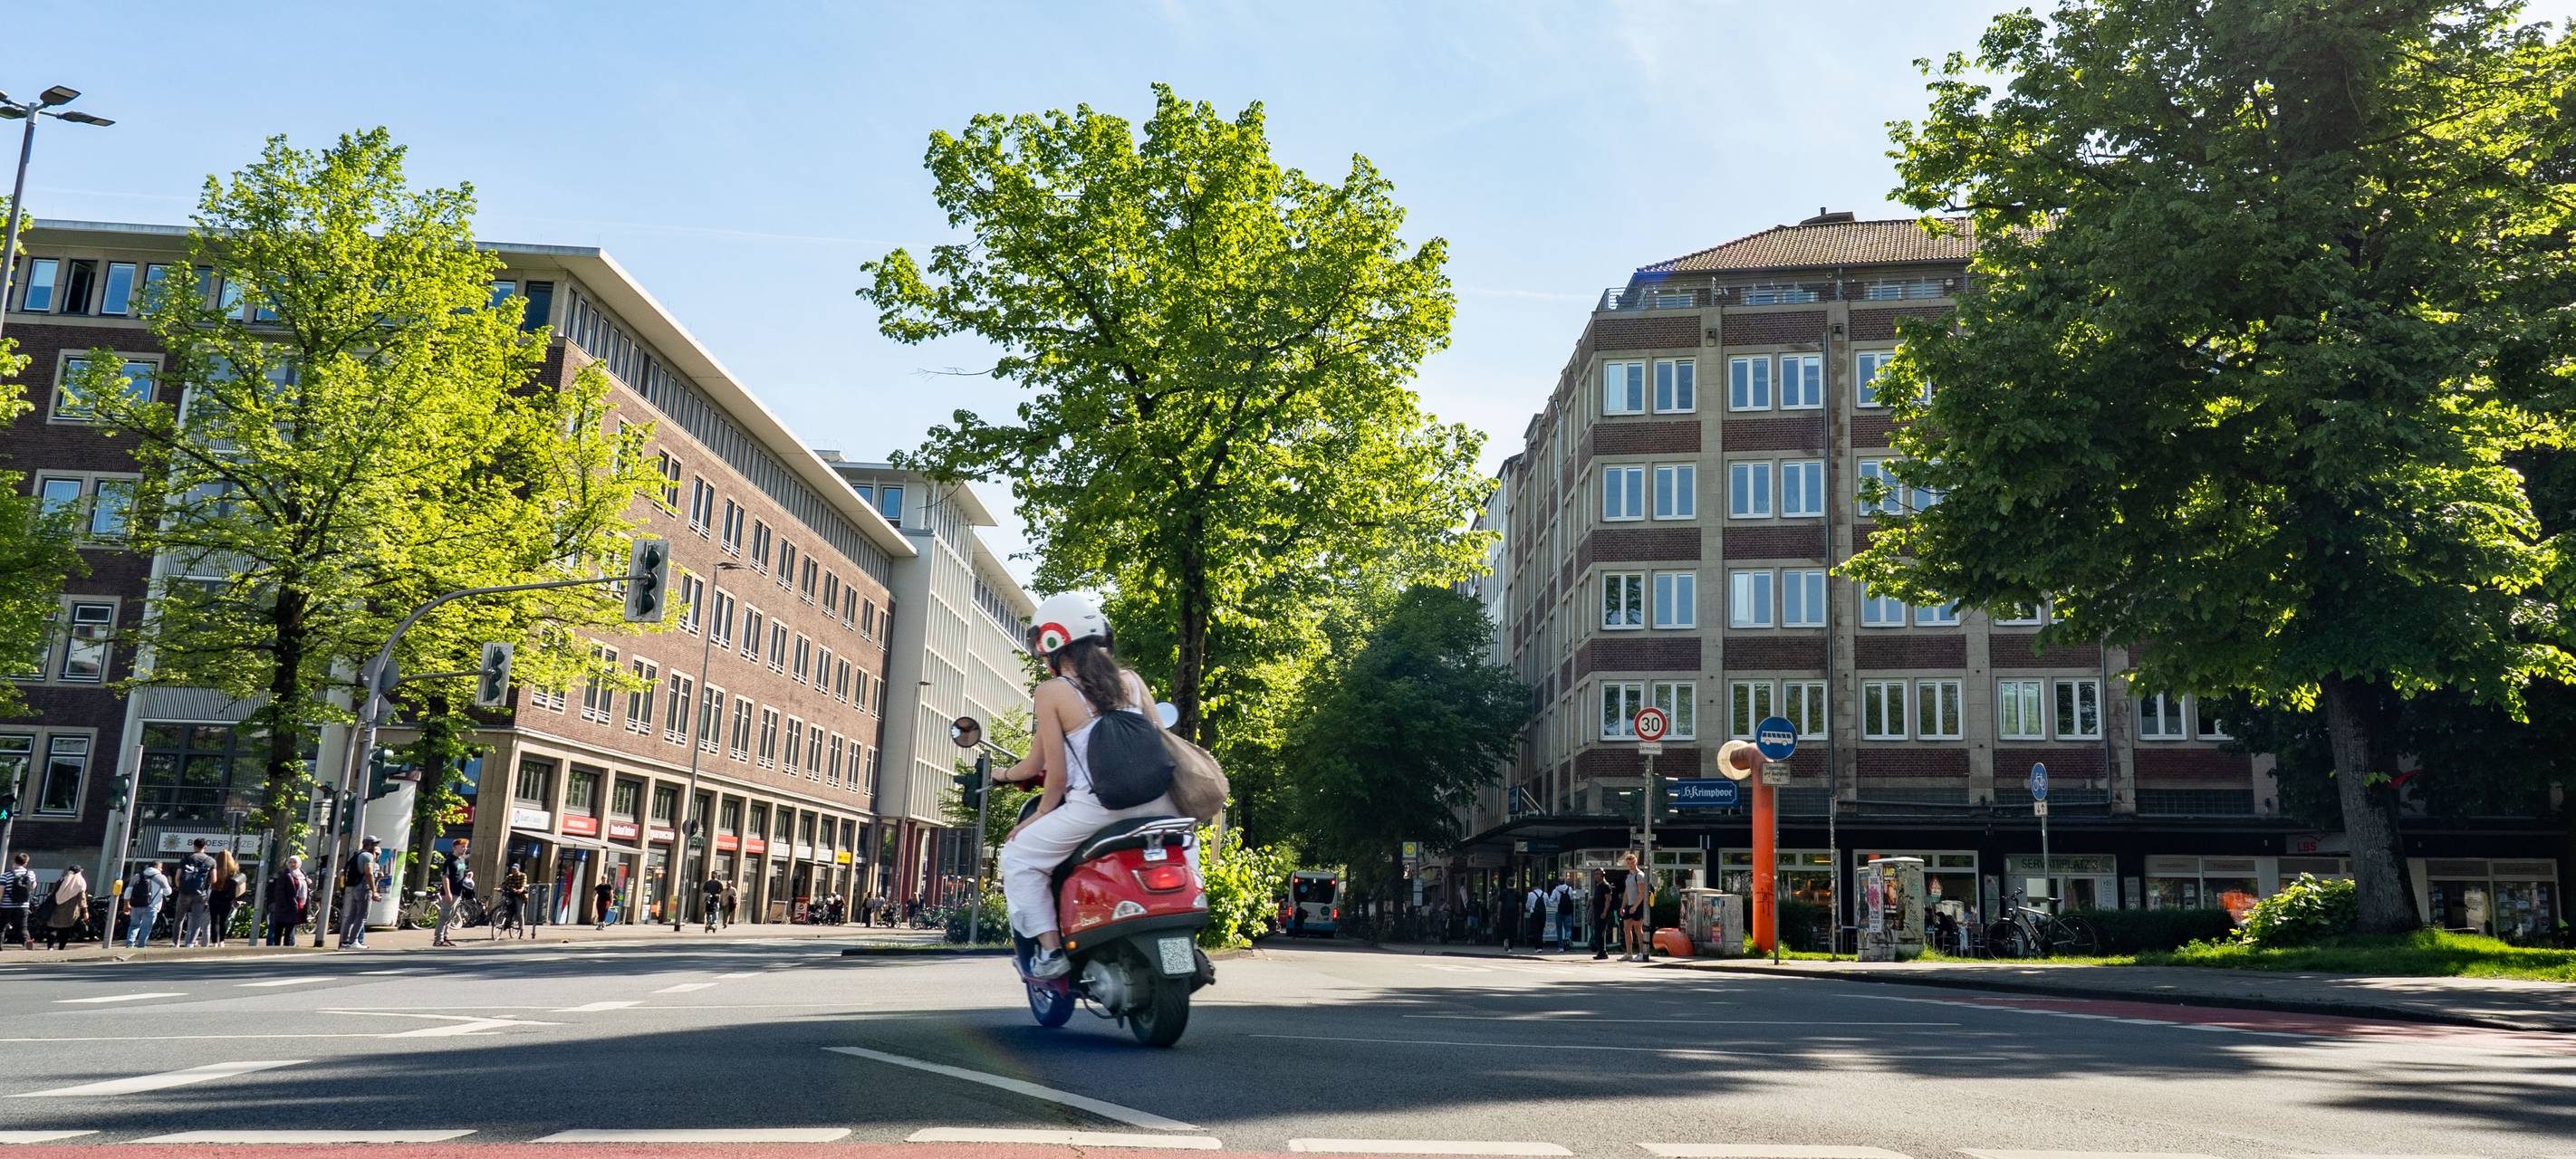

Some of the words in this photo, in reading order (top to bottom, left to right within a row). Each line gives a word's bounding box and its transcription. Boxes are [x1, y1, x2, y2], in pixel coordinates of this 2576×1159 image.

[1641, 717, 1660, 732] 30
[187, 838, 255, 848] BDESPIZEI
[2297, 840, 2317, 852] LBS
